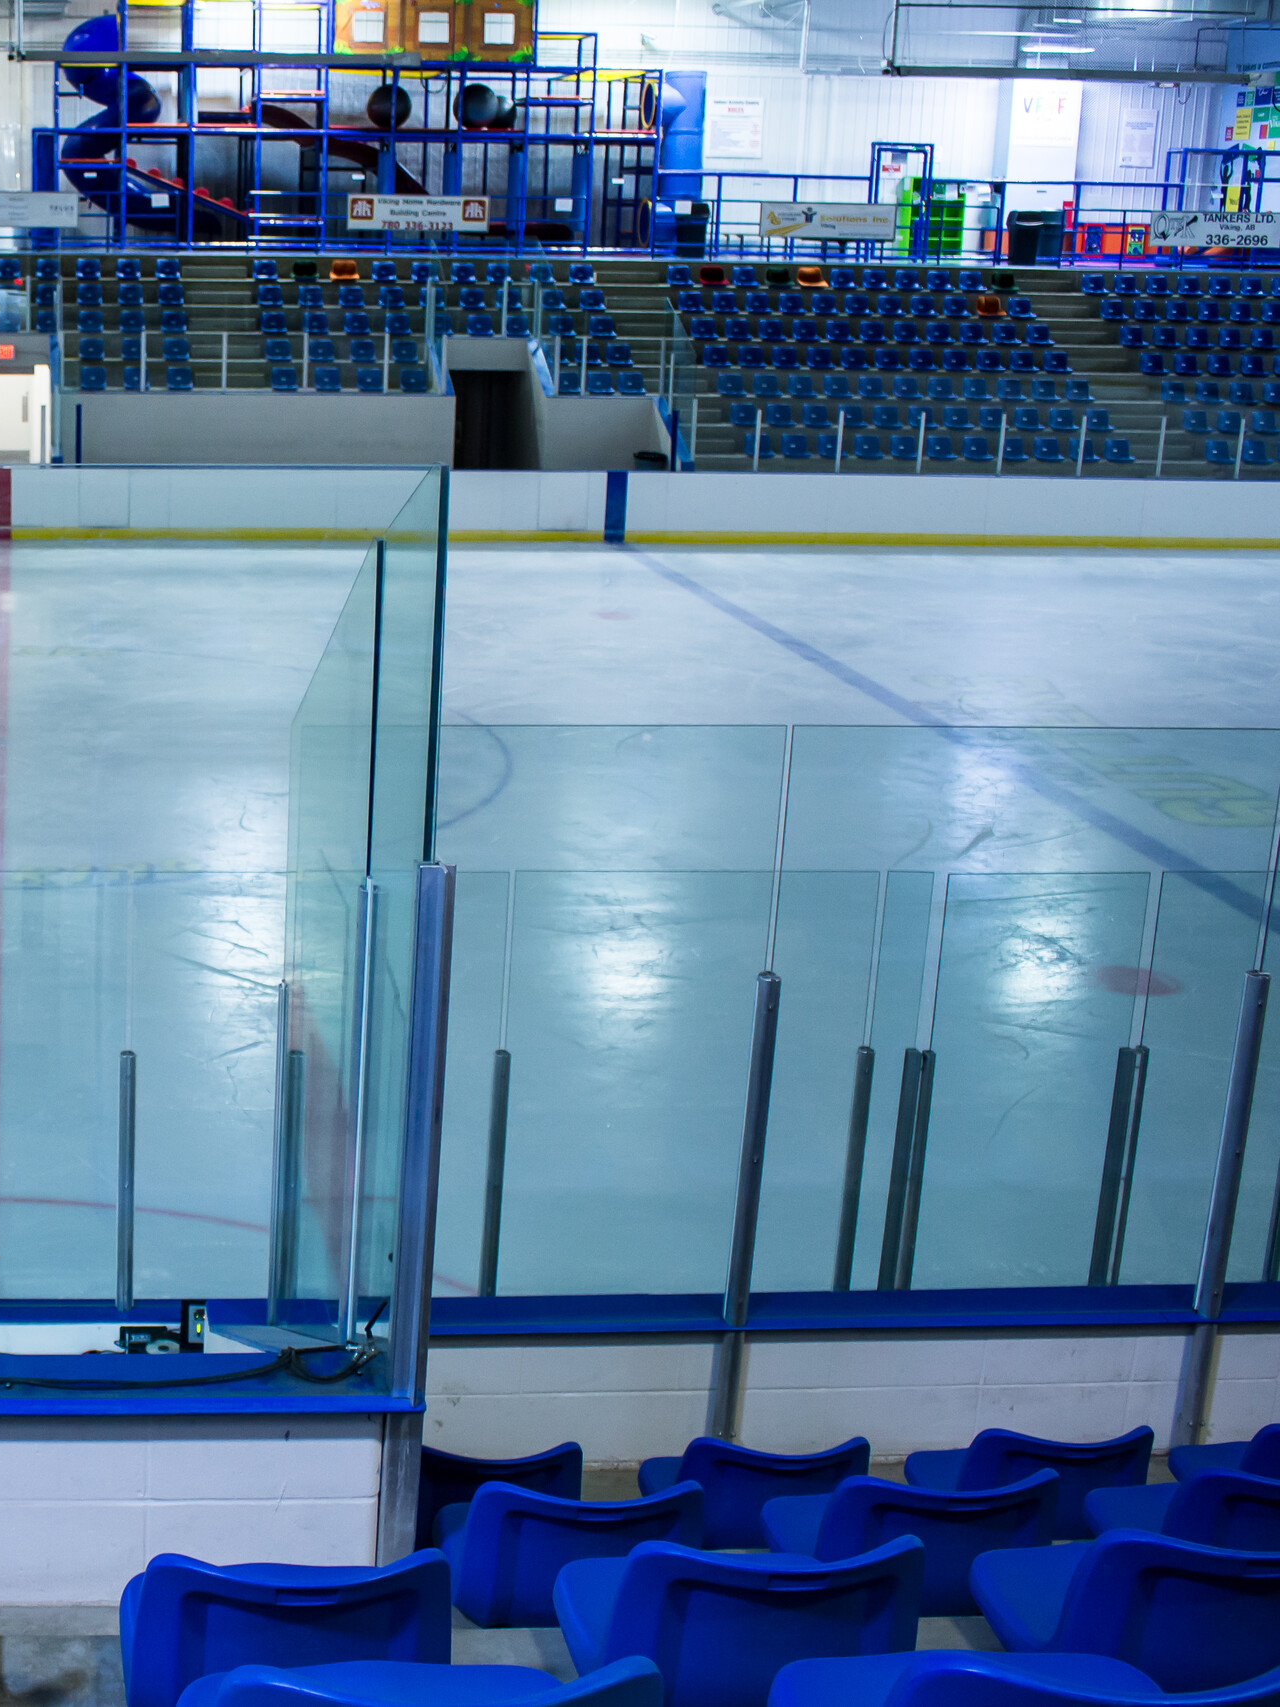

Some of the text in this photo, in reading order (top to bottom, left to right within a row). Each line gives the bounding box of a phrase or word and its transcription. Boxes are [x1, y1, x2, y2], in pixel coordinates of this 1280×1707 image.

[377, 198, 400, 206] Viking
[426, 199, 461, 207] Hardware
[390, 209, 447, 217] Building Centre
[820, 214, 868, 224] Solutions
[1202, 213, 1276, 224] TANKERS LTD.
[381, 220, 454, 231] 780 336-3123
[1205, 234, 1269, 246] 336-2696
